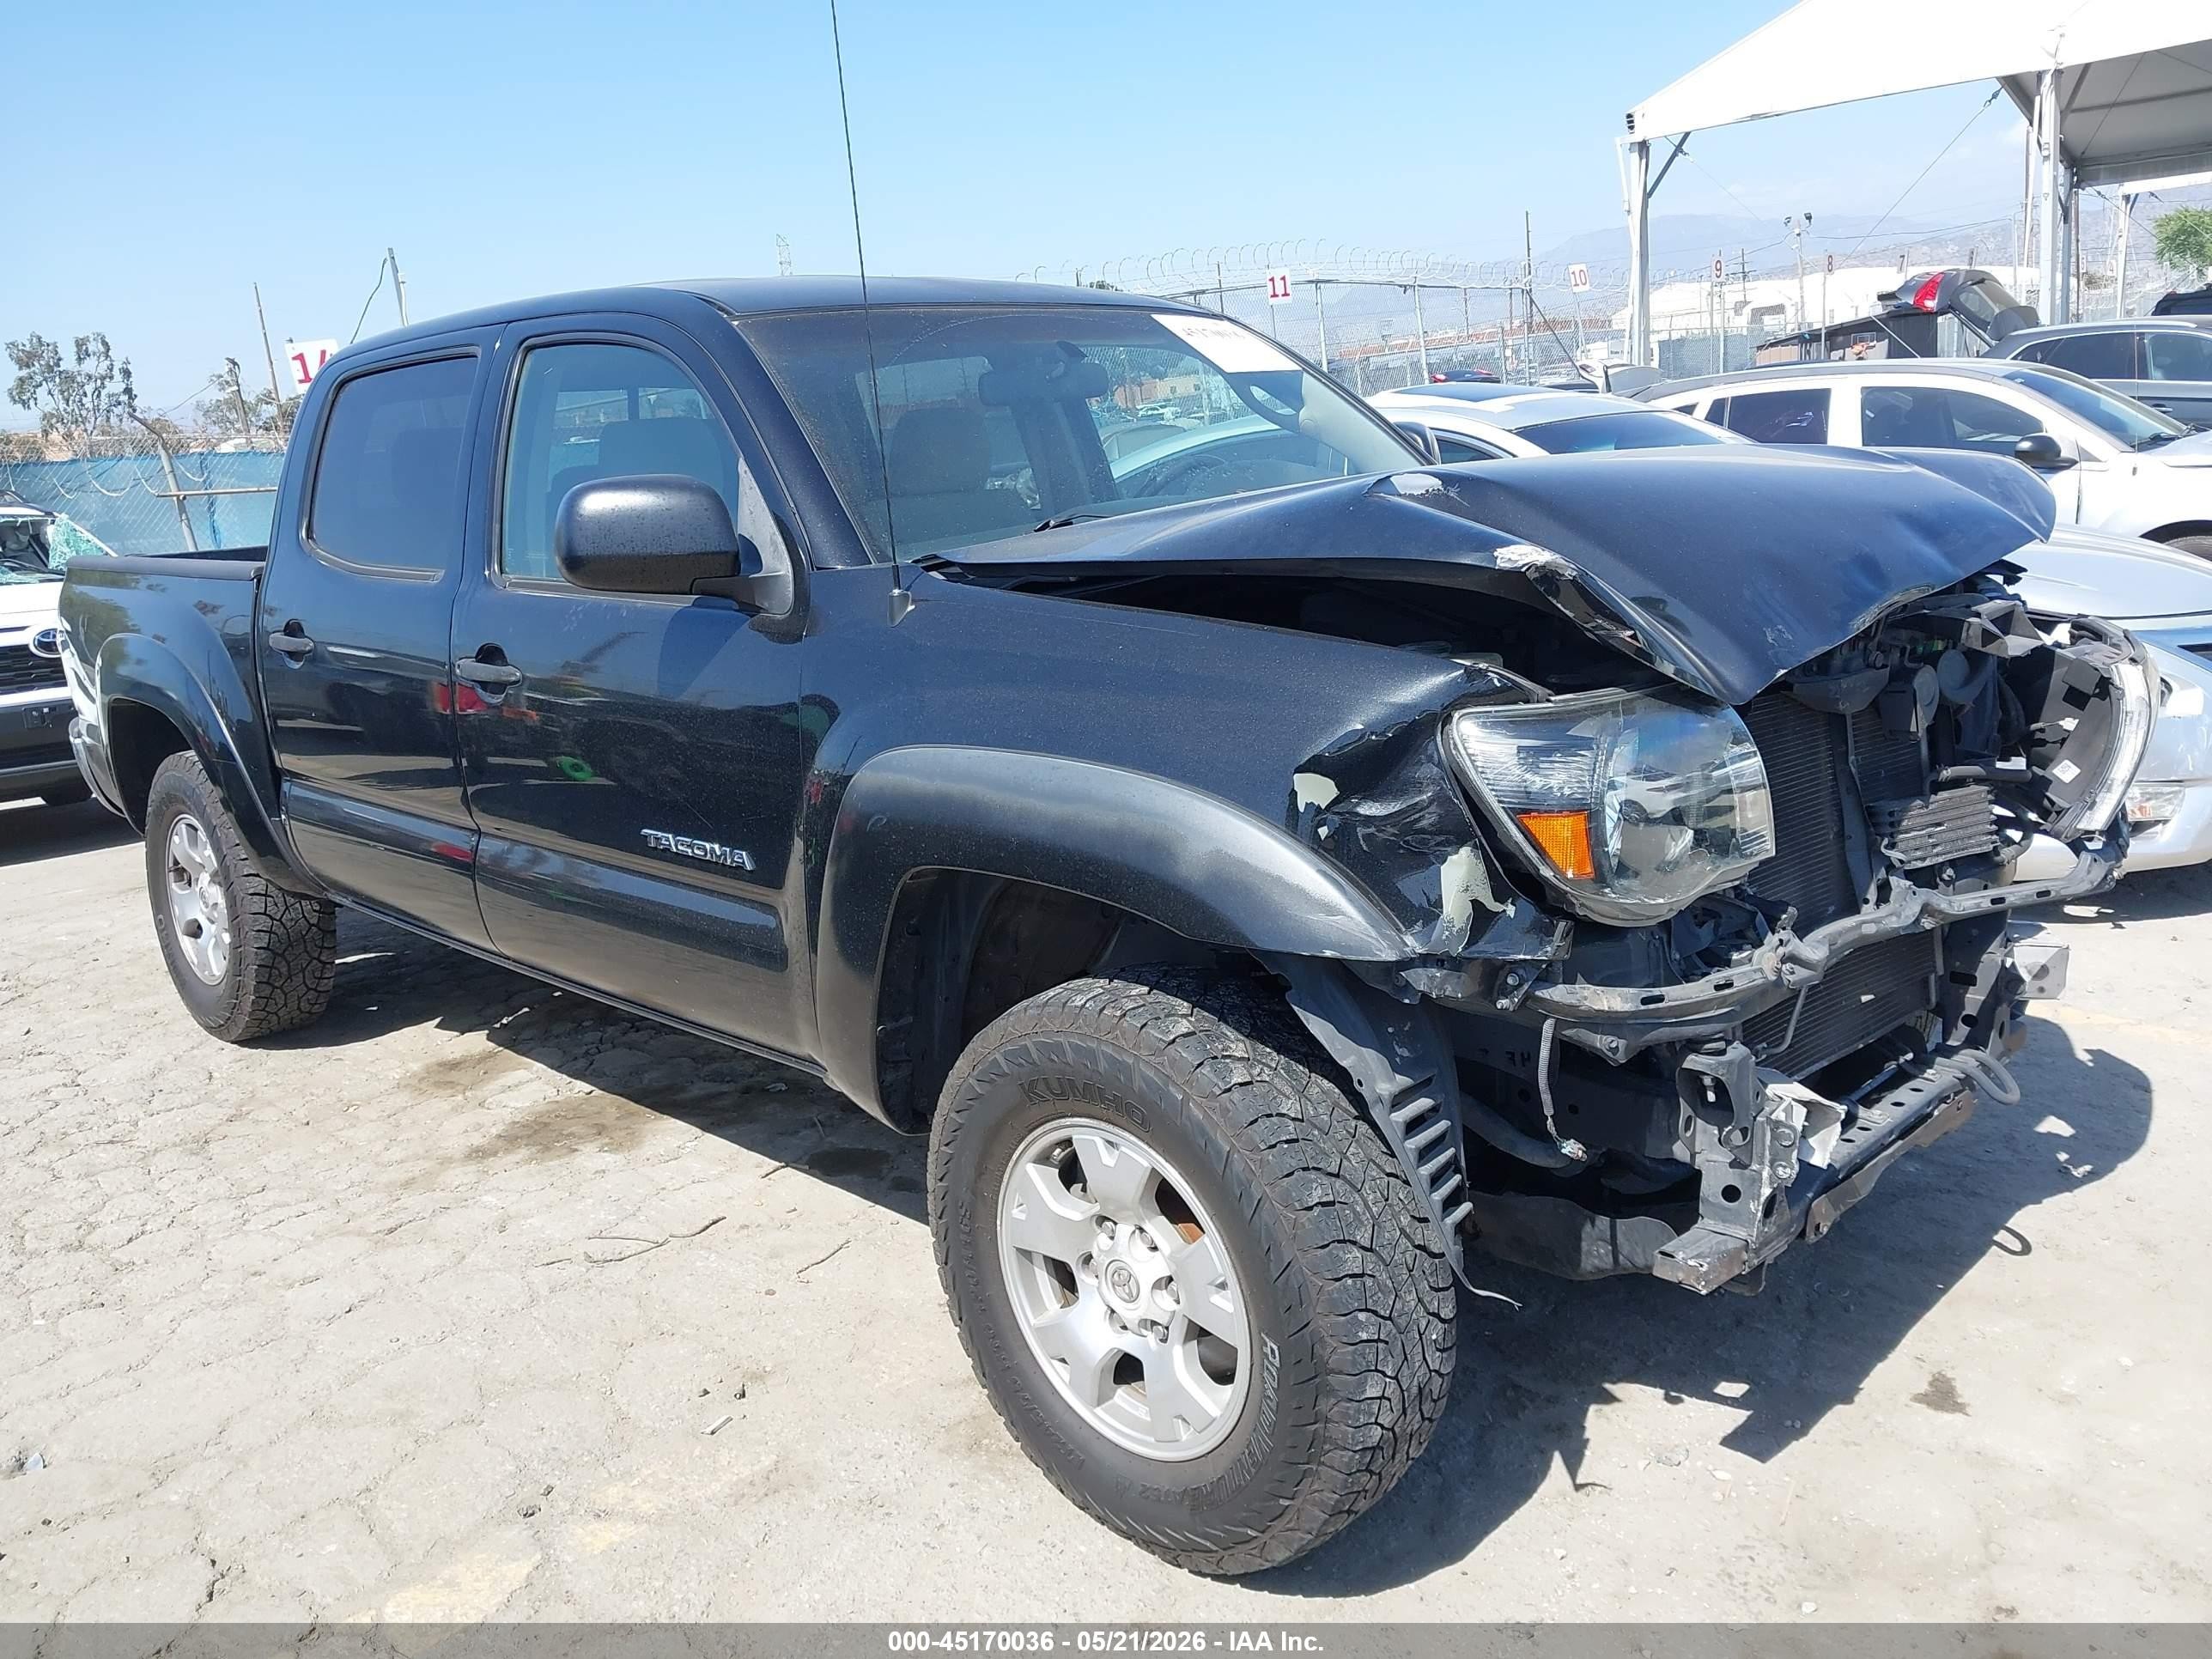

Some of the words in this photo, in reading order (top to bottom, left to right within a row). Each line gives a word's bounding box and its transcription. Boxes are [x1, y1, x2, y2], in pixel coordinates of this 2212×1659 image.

[1714, 259, 1723, 279] 9
[1827, 254, 1834, 273] 8
[1899, 254, 1905, 272] 7
[1268, 275, 1291, 299] 11
[1571, 269, 1588, 288] 10
[640, 829, 757, 872] TACOMA
[1016, 1074, 1152, 1133] KUMHO
